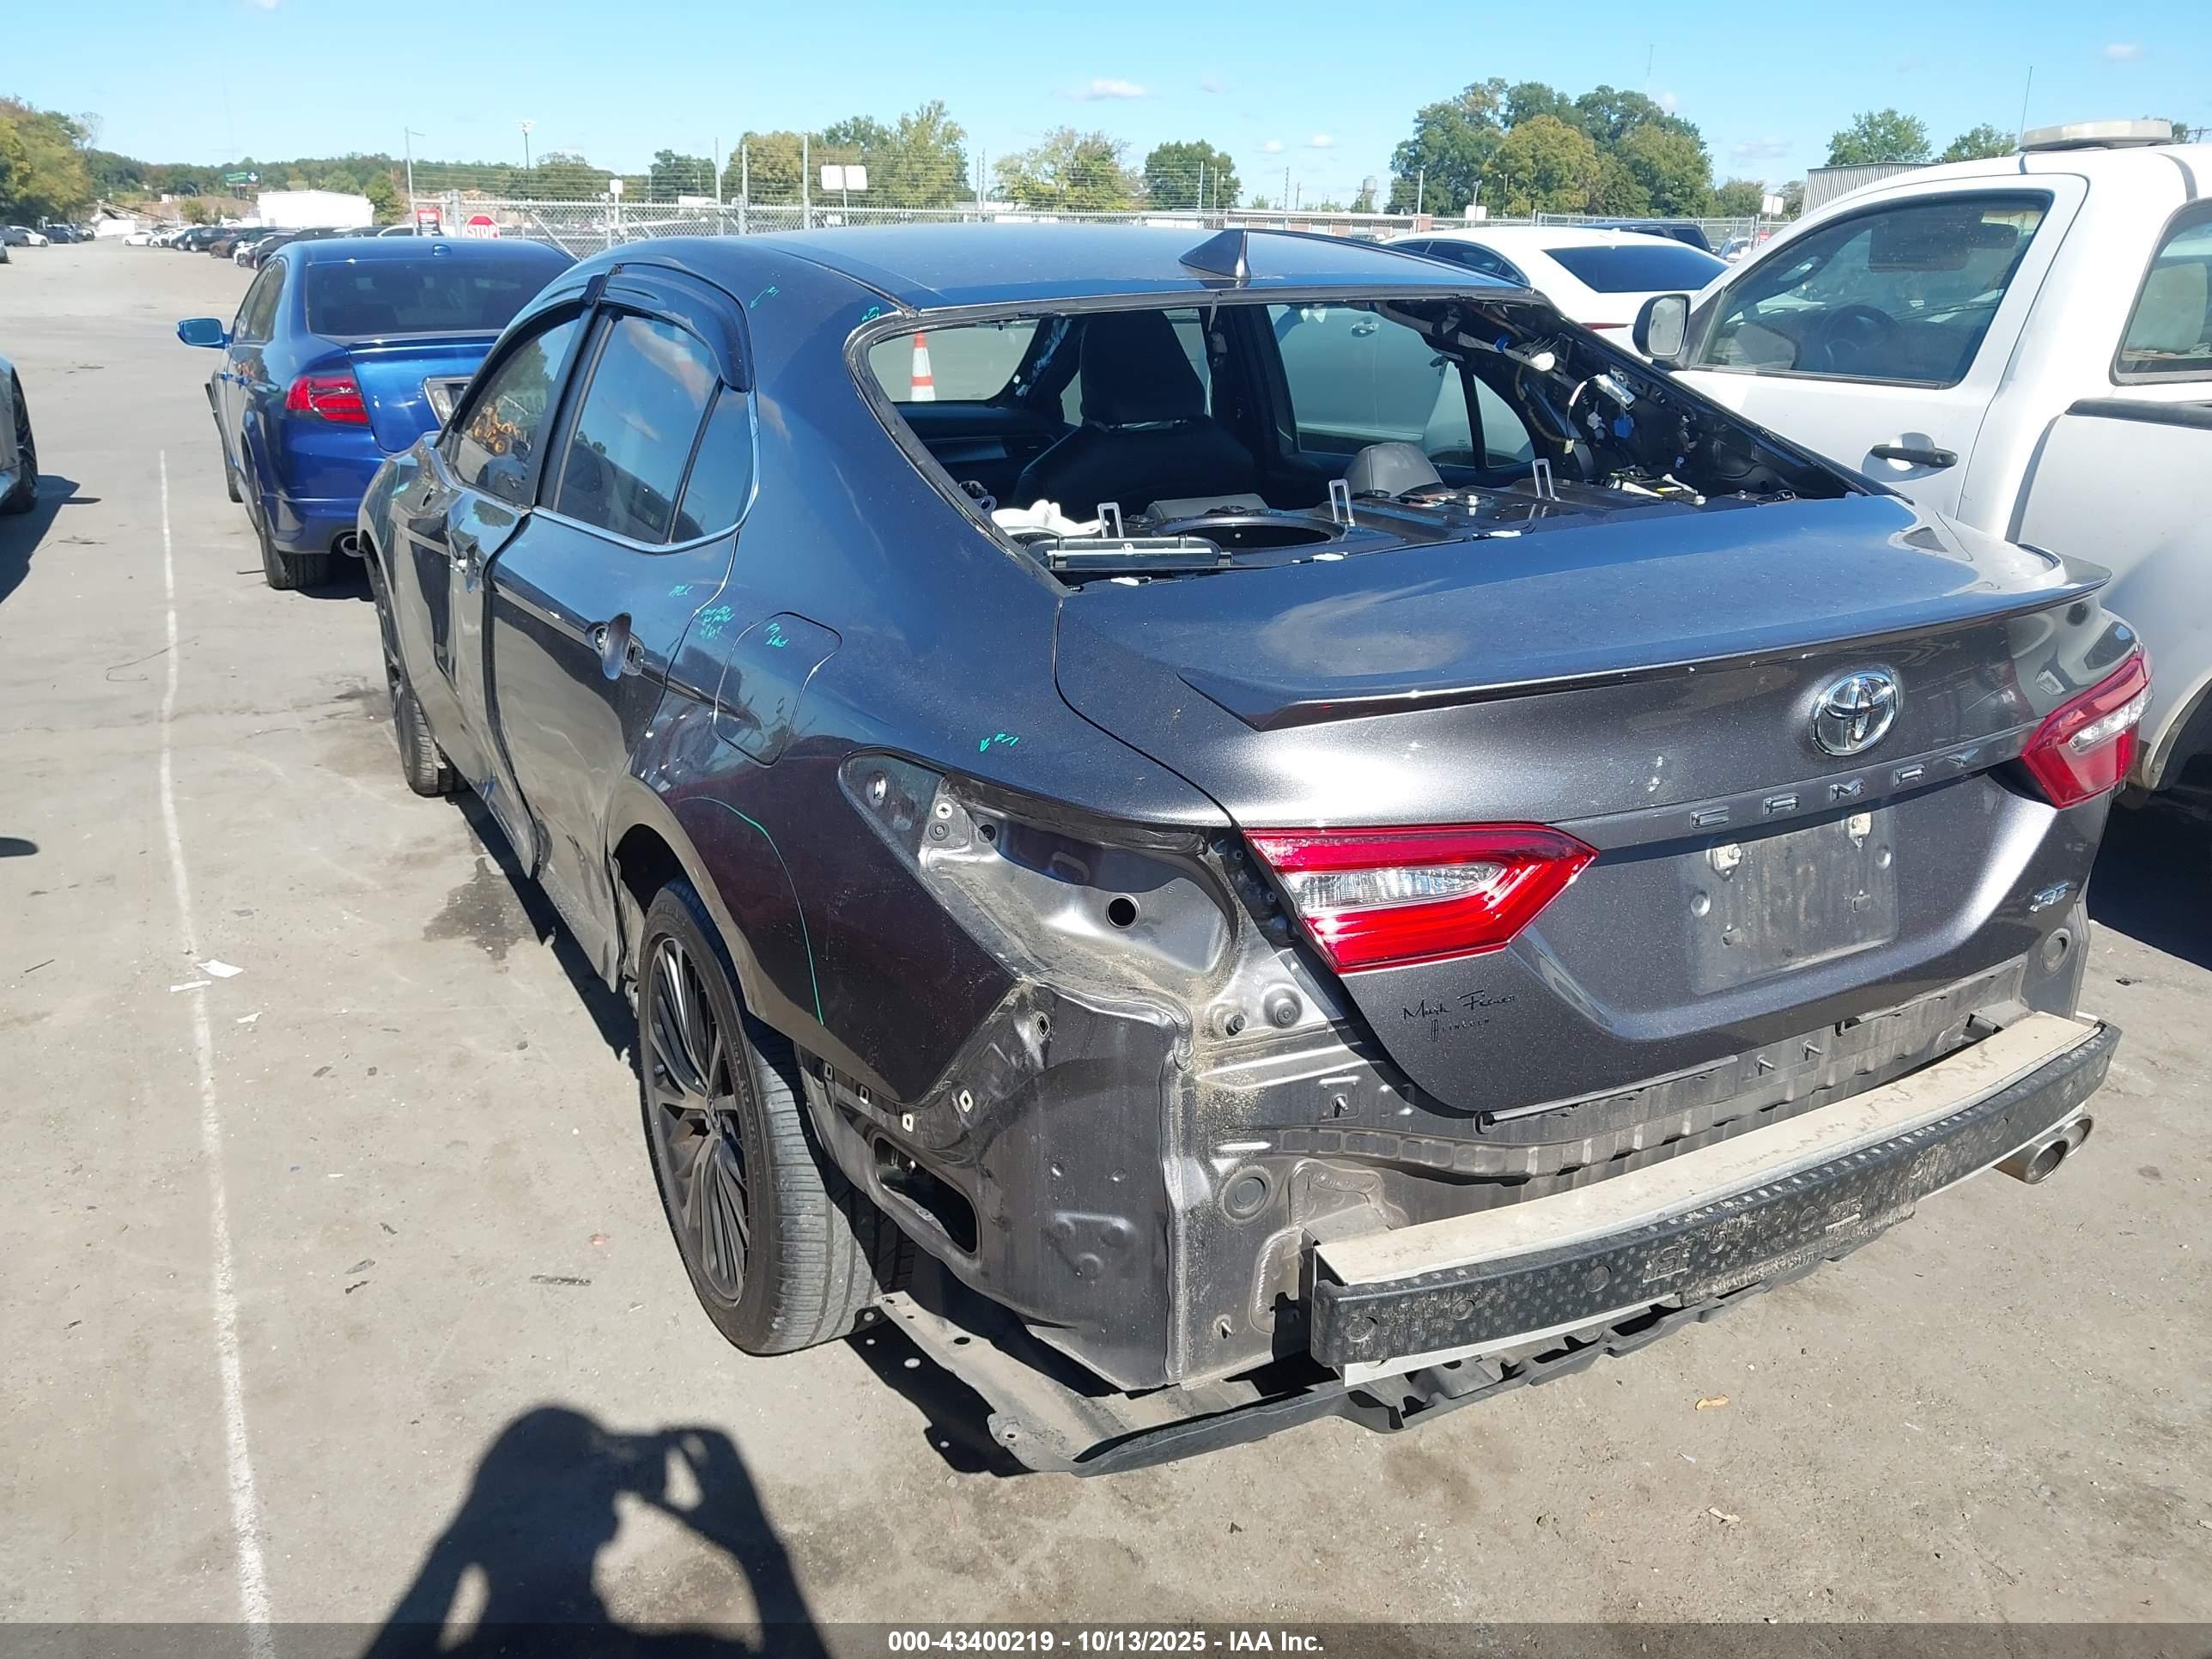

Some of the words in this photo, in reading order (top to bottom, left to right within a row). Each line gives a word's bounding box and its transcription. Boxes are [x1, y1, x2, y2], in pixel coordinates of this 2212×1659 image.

[467, 224, 498, 239] STOP
[1689, 748, 1980, 830] CAMRY
[2028, 881, 2070, 913] SE
[1442, 1018, 1490, 1032] LINCOLN
